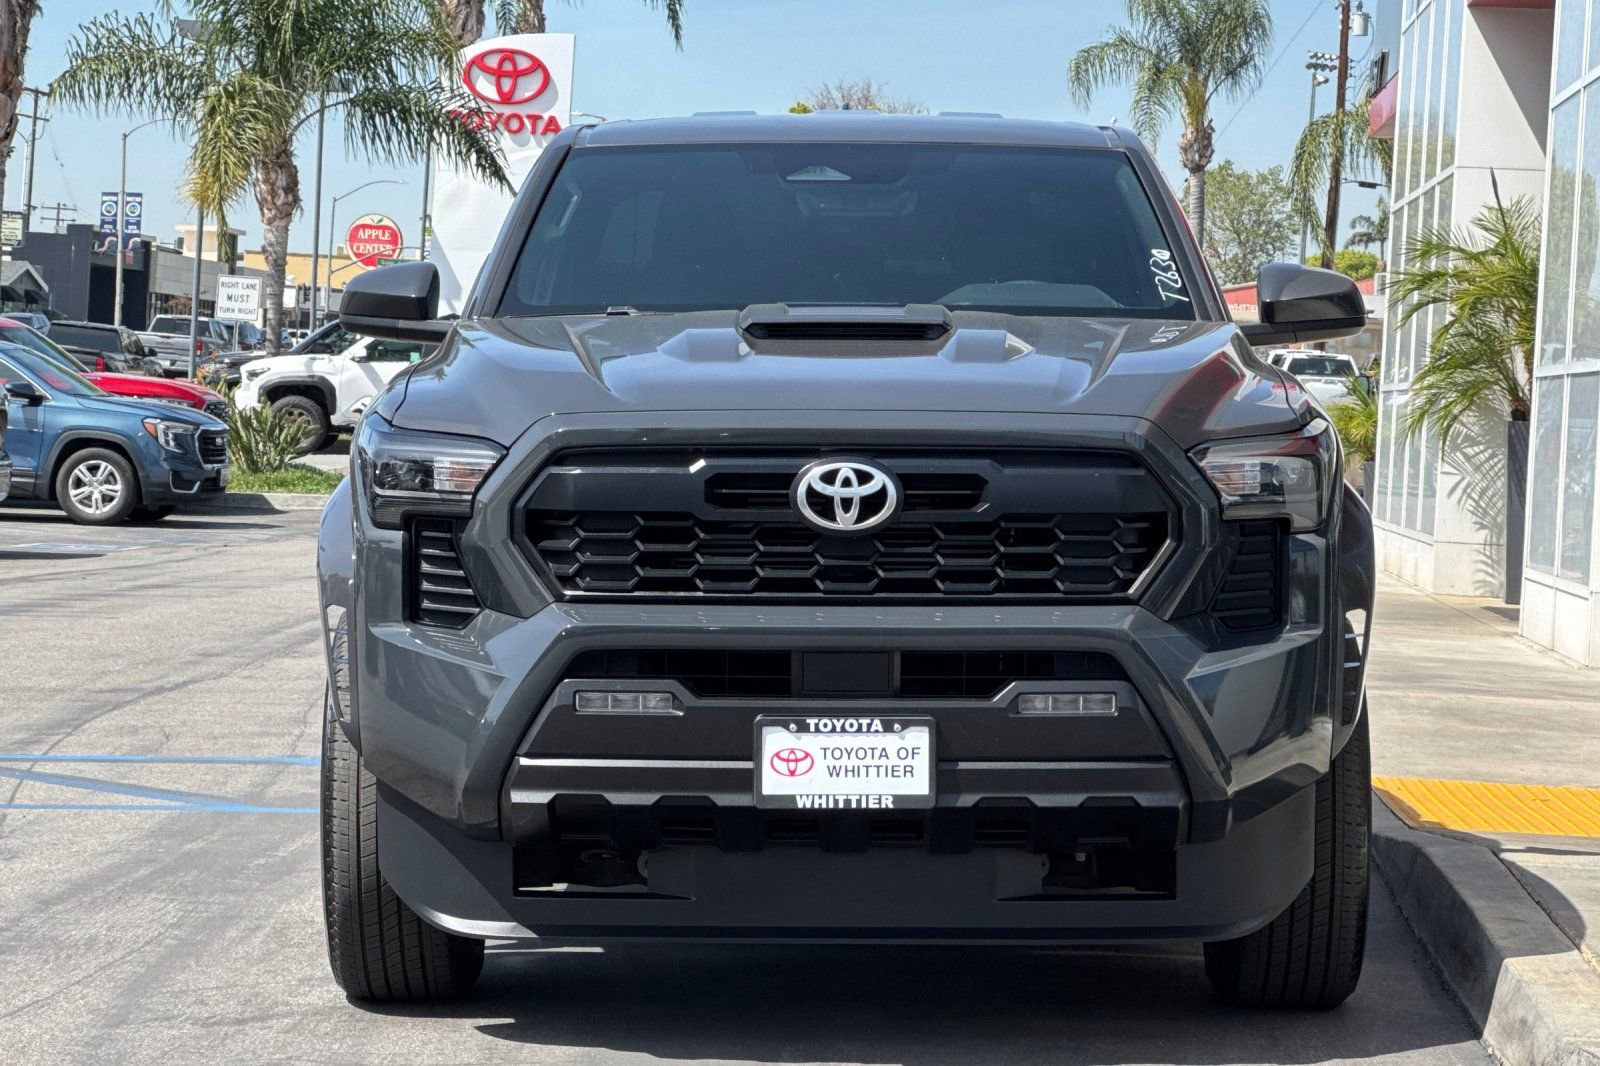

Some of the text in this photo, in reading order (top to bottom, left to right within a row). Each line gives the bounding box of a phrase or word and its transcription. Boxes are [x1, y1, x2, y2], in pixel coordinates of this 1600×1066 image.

[357, 228, 392, 240] APPLE
[353, 242, 393, 255] CENTER
[220, 281, 258, 291] RIGHT LANE
[226, 293, 250, 303] MUST
[219, 306, 257, 316] TURN RIGHT
[806, 718, 884, 733] TOYOTA
[819, 746, 921, 761] TOYOTA OF
[827, 764, 915, 779] WHITTIER
[795, 794, 895, 809] WHITTIER
